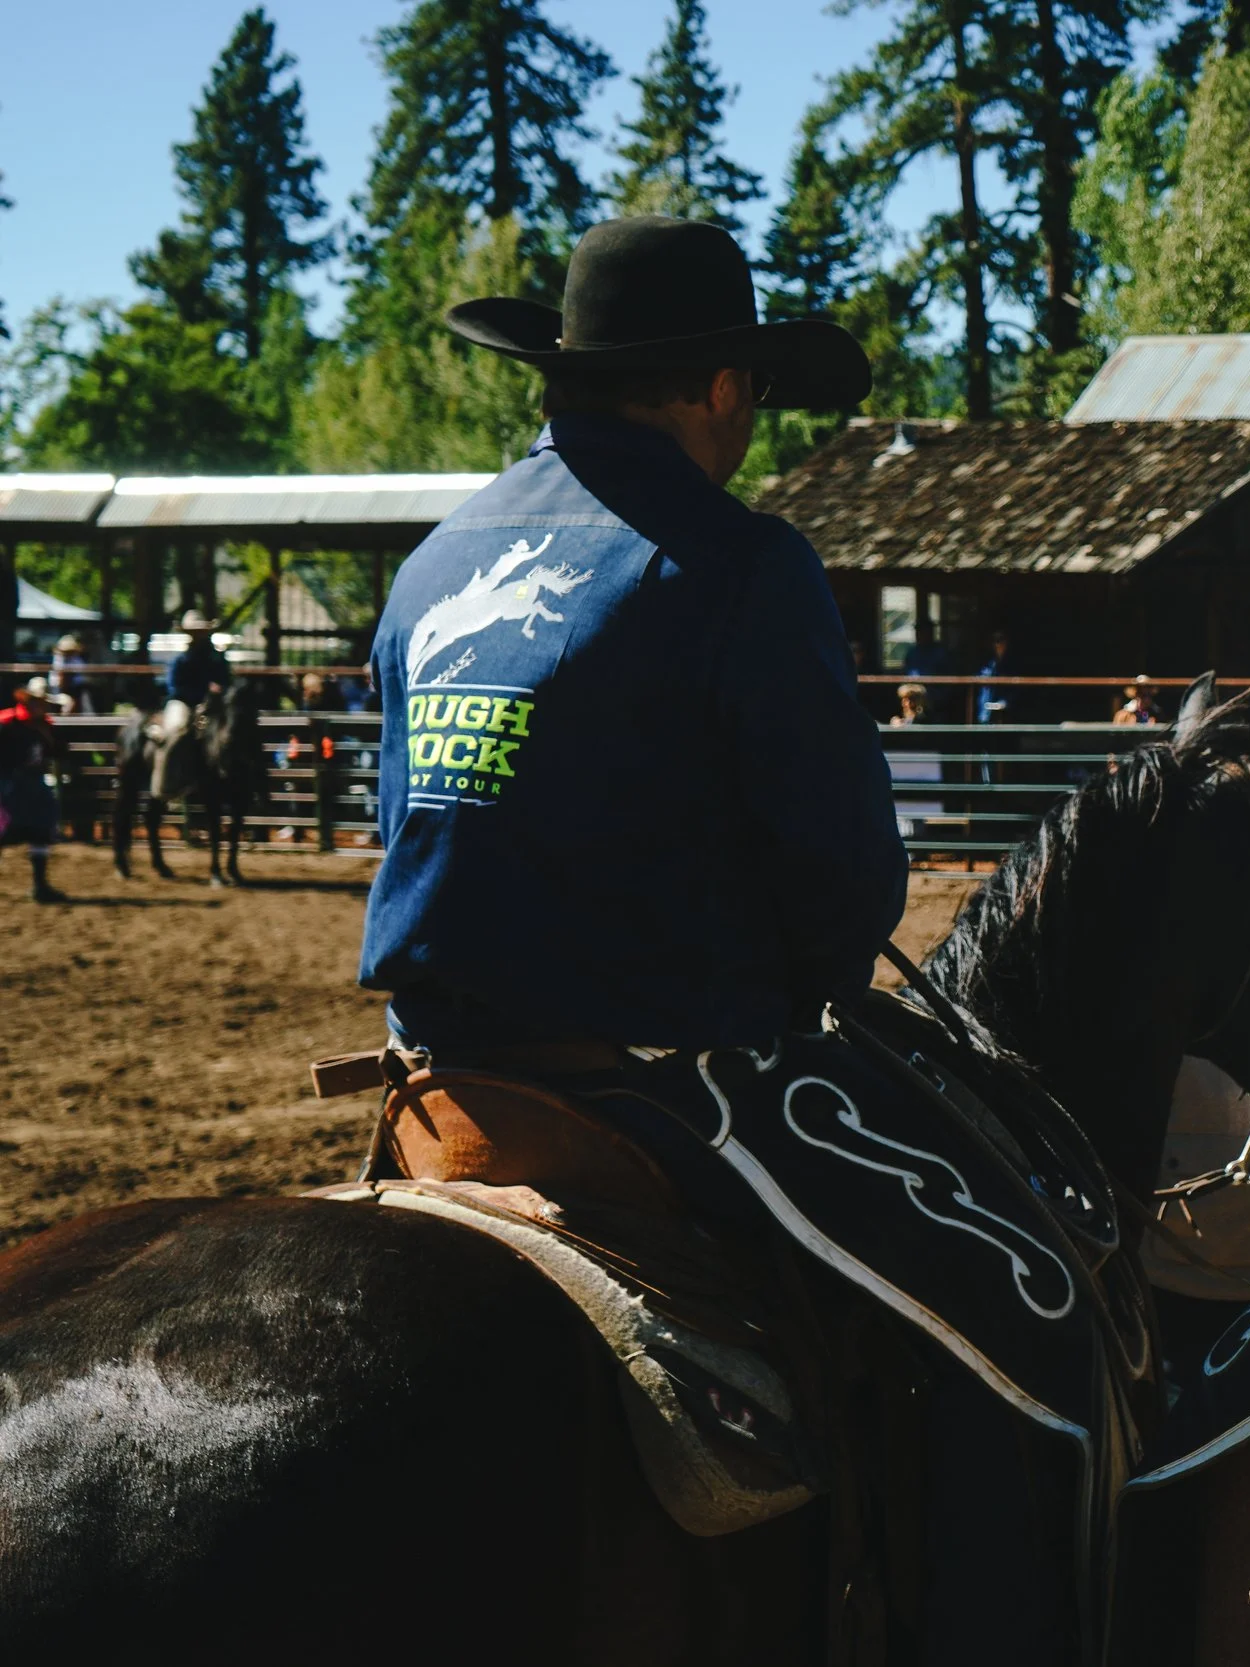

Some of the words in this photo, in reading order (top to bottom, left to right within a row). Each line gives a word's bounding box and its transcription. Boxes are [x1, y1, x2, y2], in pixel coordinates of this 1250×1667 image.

[408, 694, 535, 737] OUGH
[408, 732, 520, 777] OCK
[444, 775, 501, 794] TOUR
